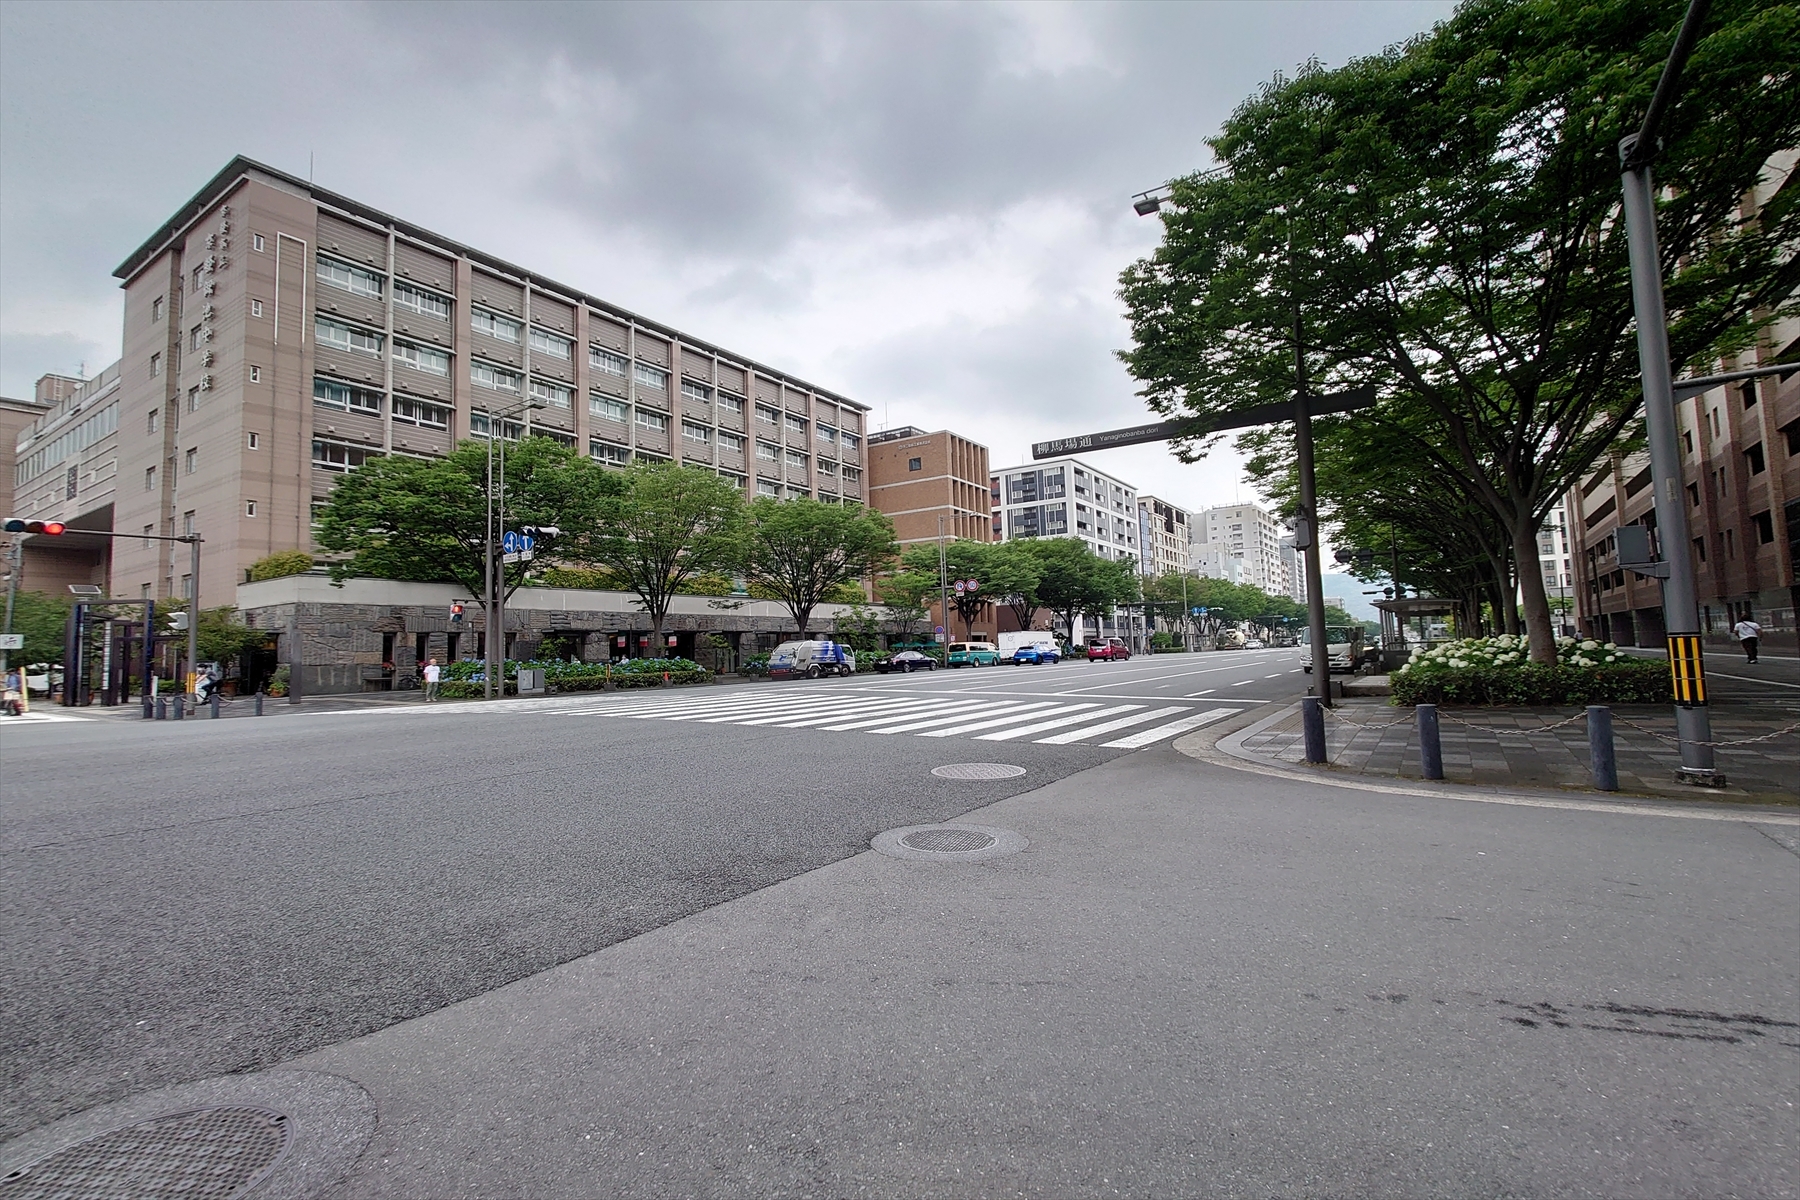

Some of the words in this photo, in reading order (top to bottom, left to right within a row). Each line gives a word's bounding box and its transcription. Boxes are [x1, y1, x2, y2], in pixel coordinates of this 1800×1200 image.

[1099, 430, 1145, 441] Yanaginobanba
[1037, 435, 1093, 454] 柳馬場通
